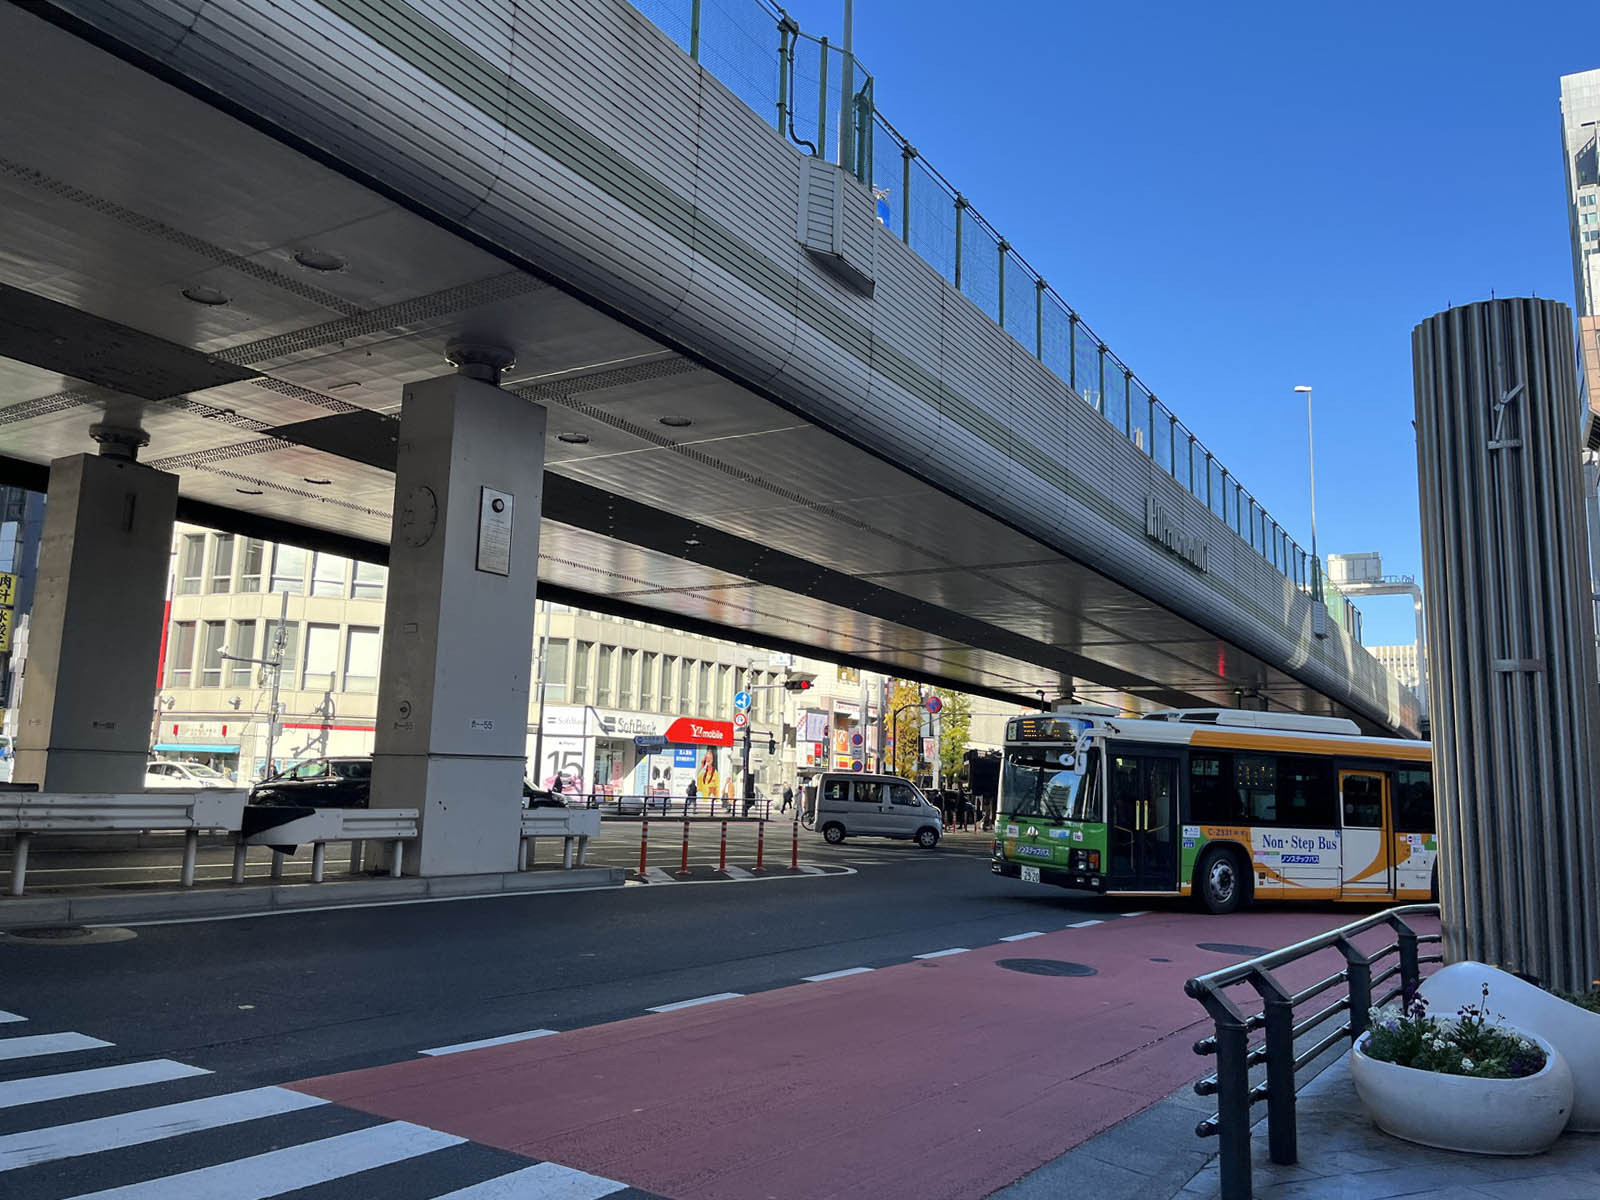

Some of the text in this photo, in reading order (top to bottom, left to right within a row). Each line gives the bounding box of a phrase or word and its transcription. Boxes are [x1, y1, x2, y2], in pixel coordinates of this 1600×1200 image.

[617, 717, 657, 735] SoftBank
[1318, 836, 1337, 850] Bus
[1282, 855, 1319, 864] ノンステップバス
